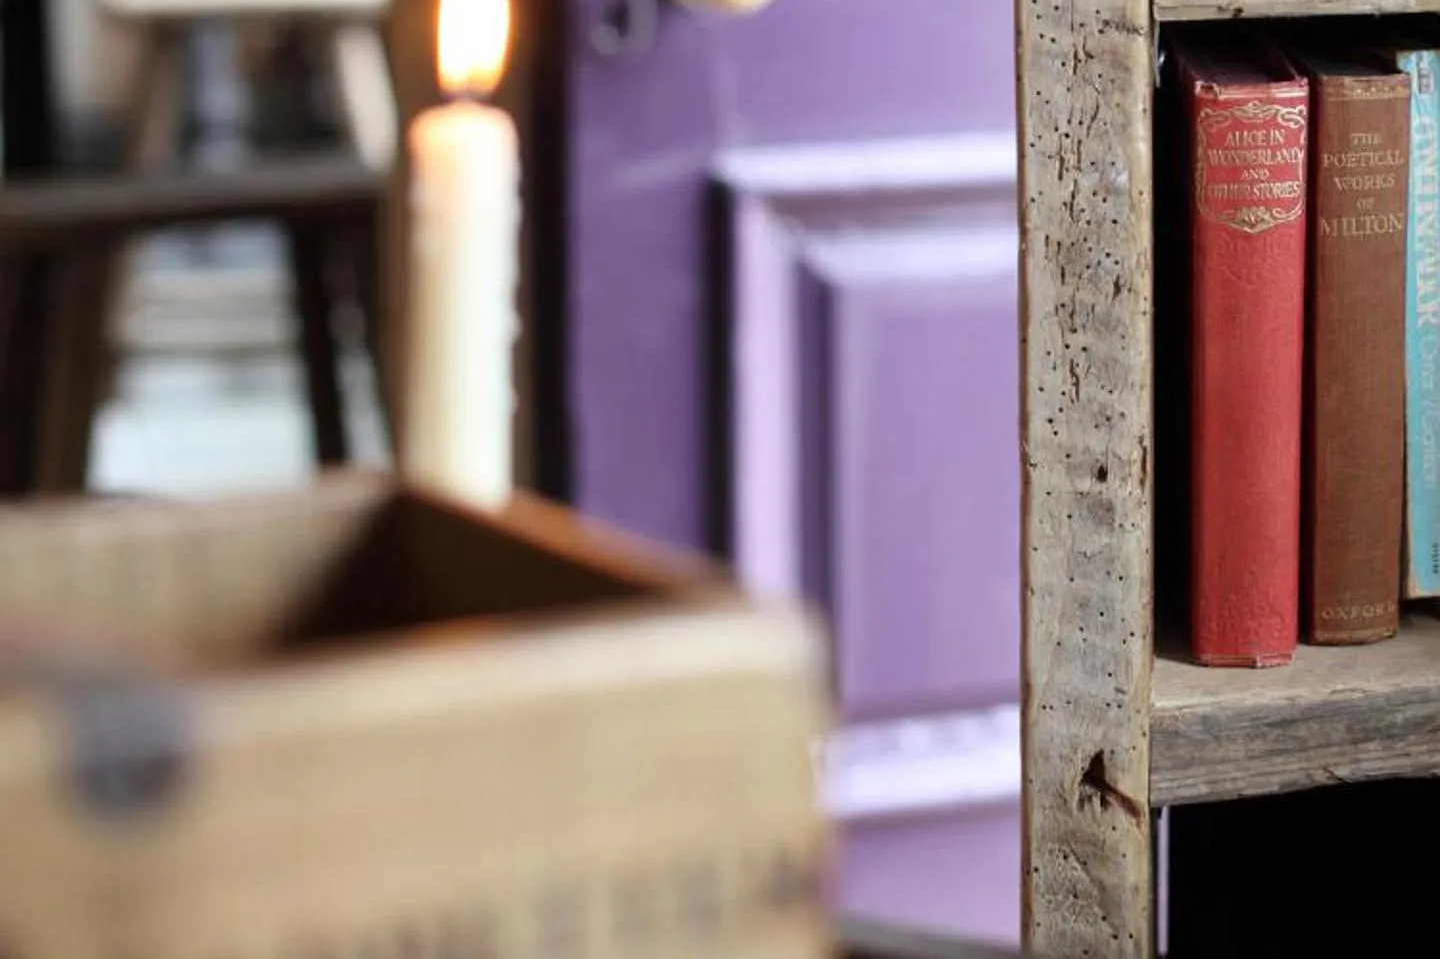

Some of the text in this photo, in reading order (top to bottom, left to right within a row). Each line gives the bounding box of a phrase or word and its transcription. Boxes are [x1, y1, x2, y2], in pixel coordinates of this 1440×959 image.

[1225, 128, 1286, 145] ALICE IN
[1350, 133, 1384, 145] THE
[1207, 148, 1302, 166] WONDERLAND
[1322, 151, 1404, 168] POETICAL
[1239, 169, 1270, 179] AND
[1334, 174, 1397, 190] WORKS
[1207, 182, 1301, 200] OTHER STORIES
[1320, 215, 1404, 236] MILTON
